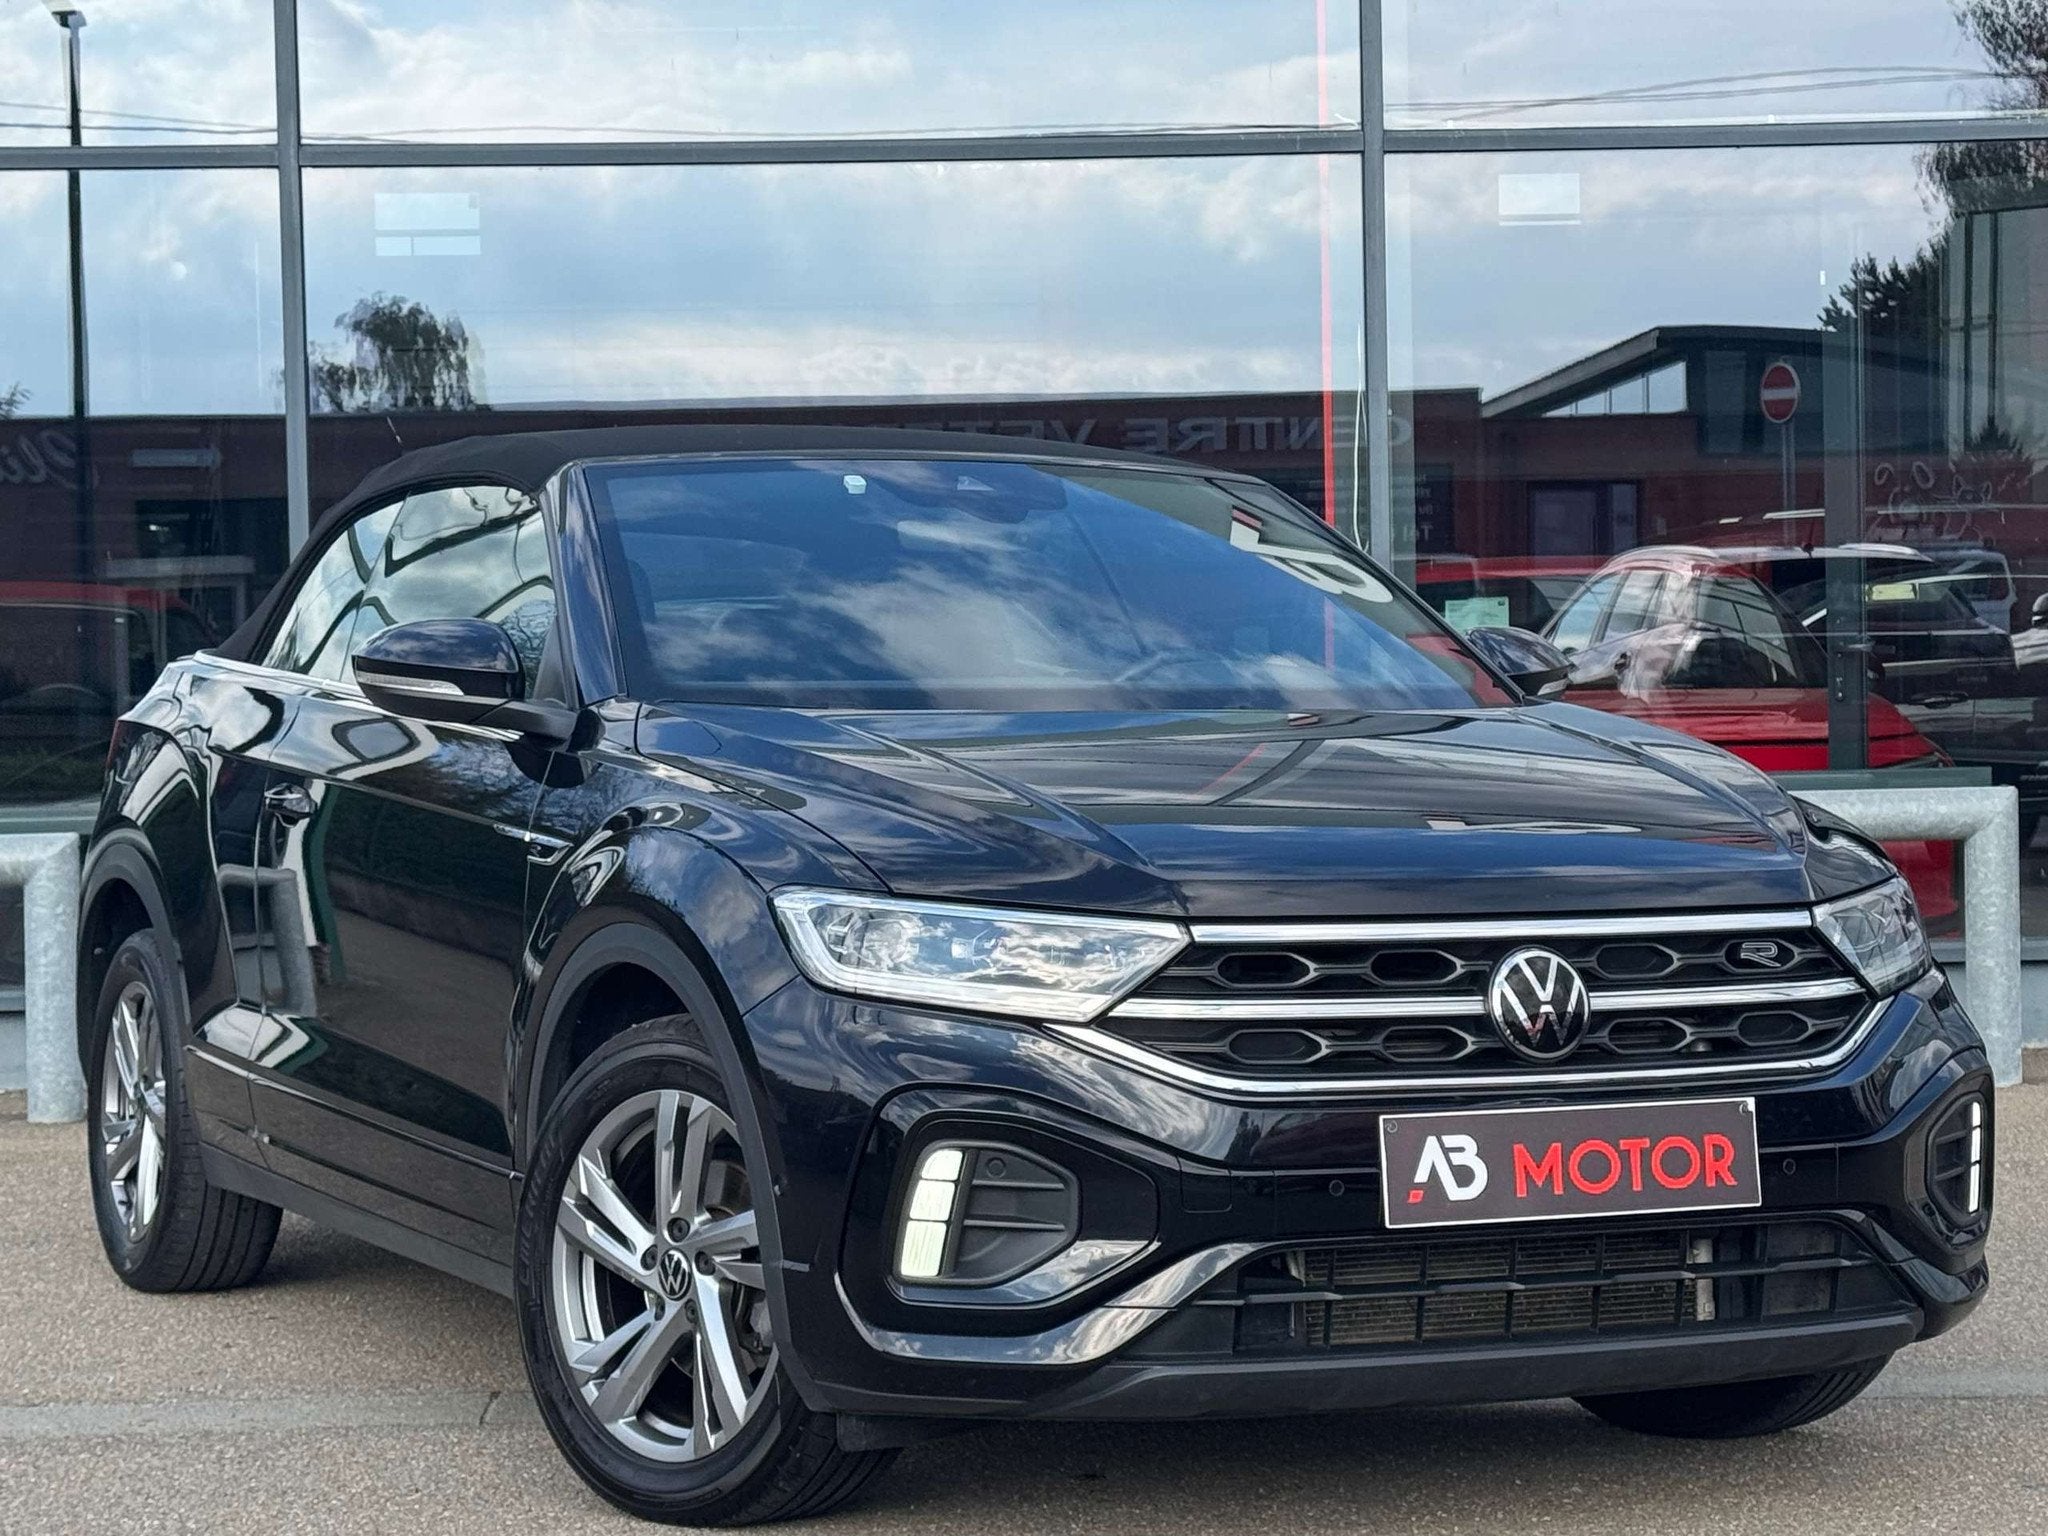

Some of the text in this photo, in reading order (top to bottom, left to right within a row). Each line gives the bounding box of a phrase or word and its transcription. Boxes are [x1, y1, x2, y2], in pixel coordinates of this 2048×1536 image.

[1495, 952, 1586, 1052] VW
[1407, 1133, 1738, 1204] AB MOTOR
[659, 1250, 690, 1297] VW
